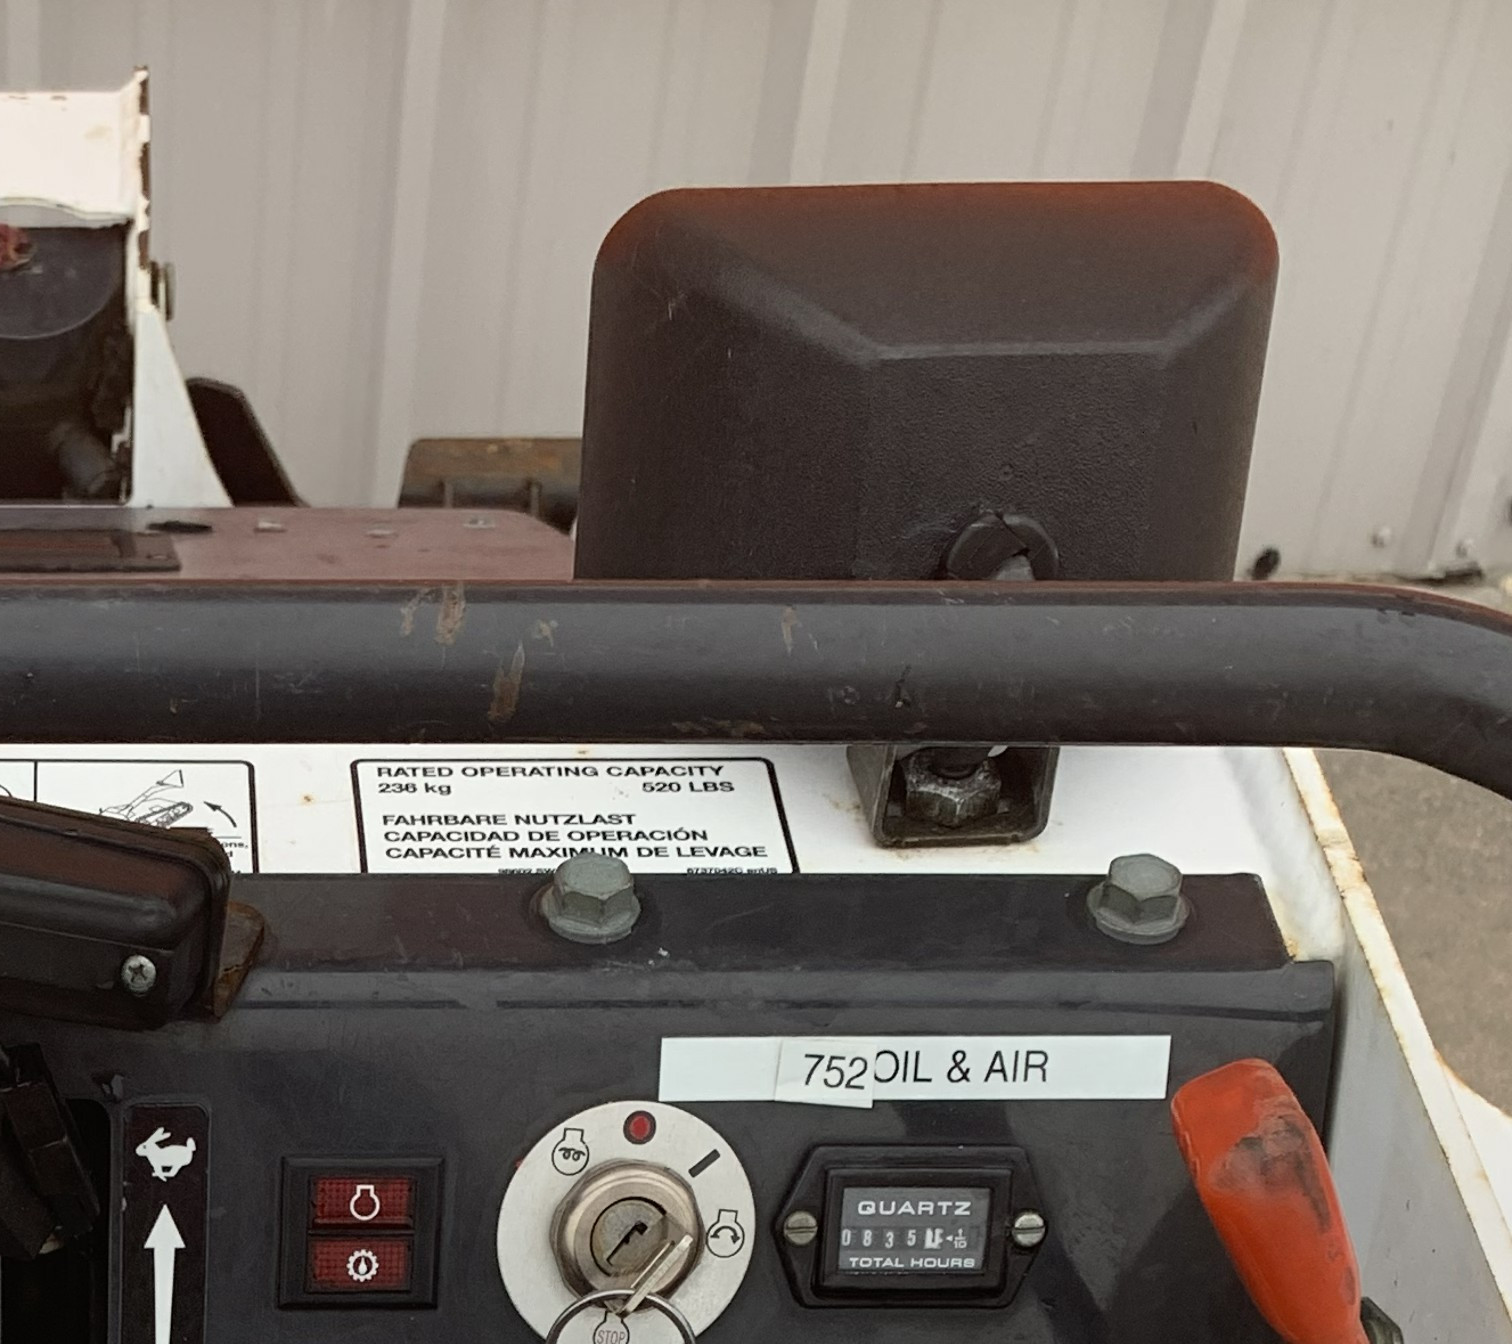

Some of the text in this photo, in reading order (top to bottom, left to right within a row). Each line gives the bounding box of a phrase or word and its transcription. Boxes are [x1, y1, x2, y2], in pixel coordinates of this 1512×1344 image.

[377, 765, 724, 777] RATED OPERATING CAPACITY
[378, 782, 452, 796] 236 kg
[642, 781, 735, 793] 520 LBS
[382, 813, 636, 826] FAHRBARE NUTZLAST
[384, 827, 708, 842] CAPACIDAD DE OPERACIÓN
[385, 845, 501, 858] CAPACITÉ
[637, 846, 669, 857] DE
[676, 846, 768, 857] LEVAGE
[803, 1049, 1049, 1090] 752 OIL & AIR
[858, 1200, 972, 1216] QUARTZ
[849, 1257, 976, 1268] TOTAL HOURS
